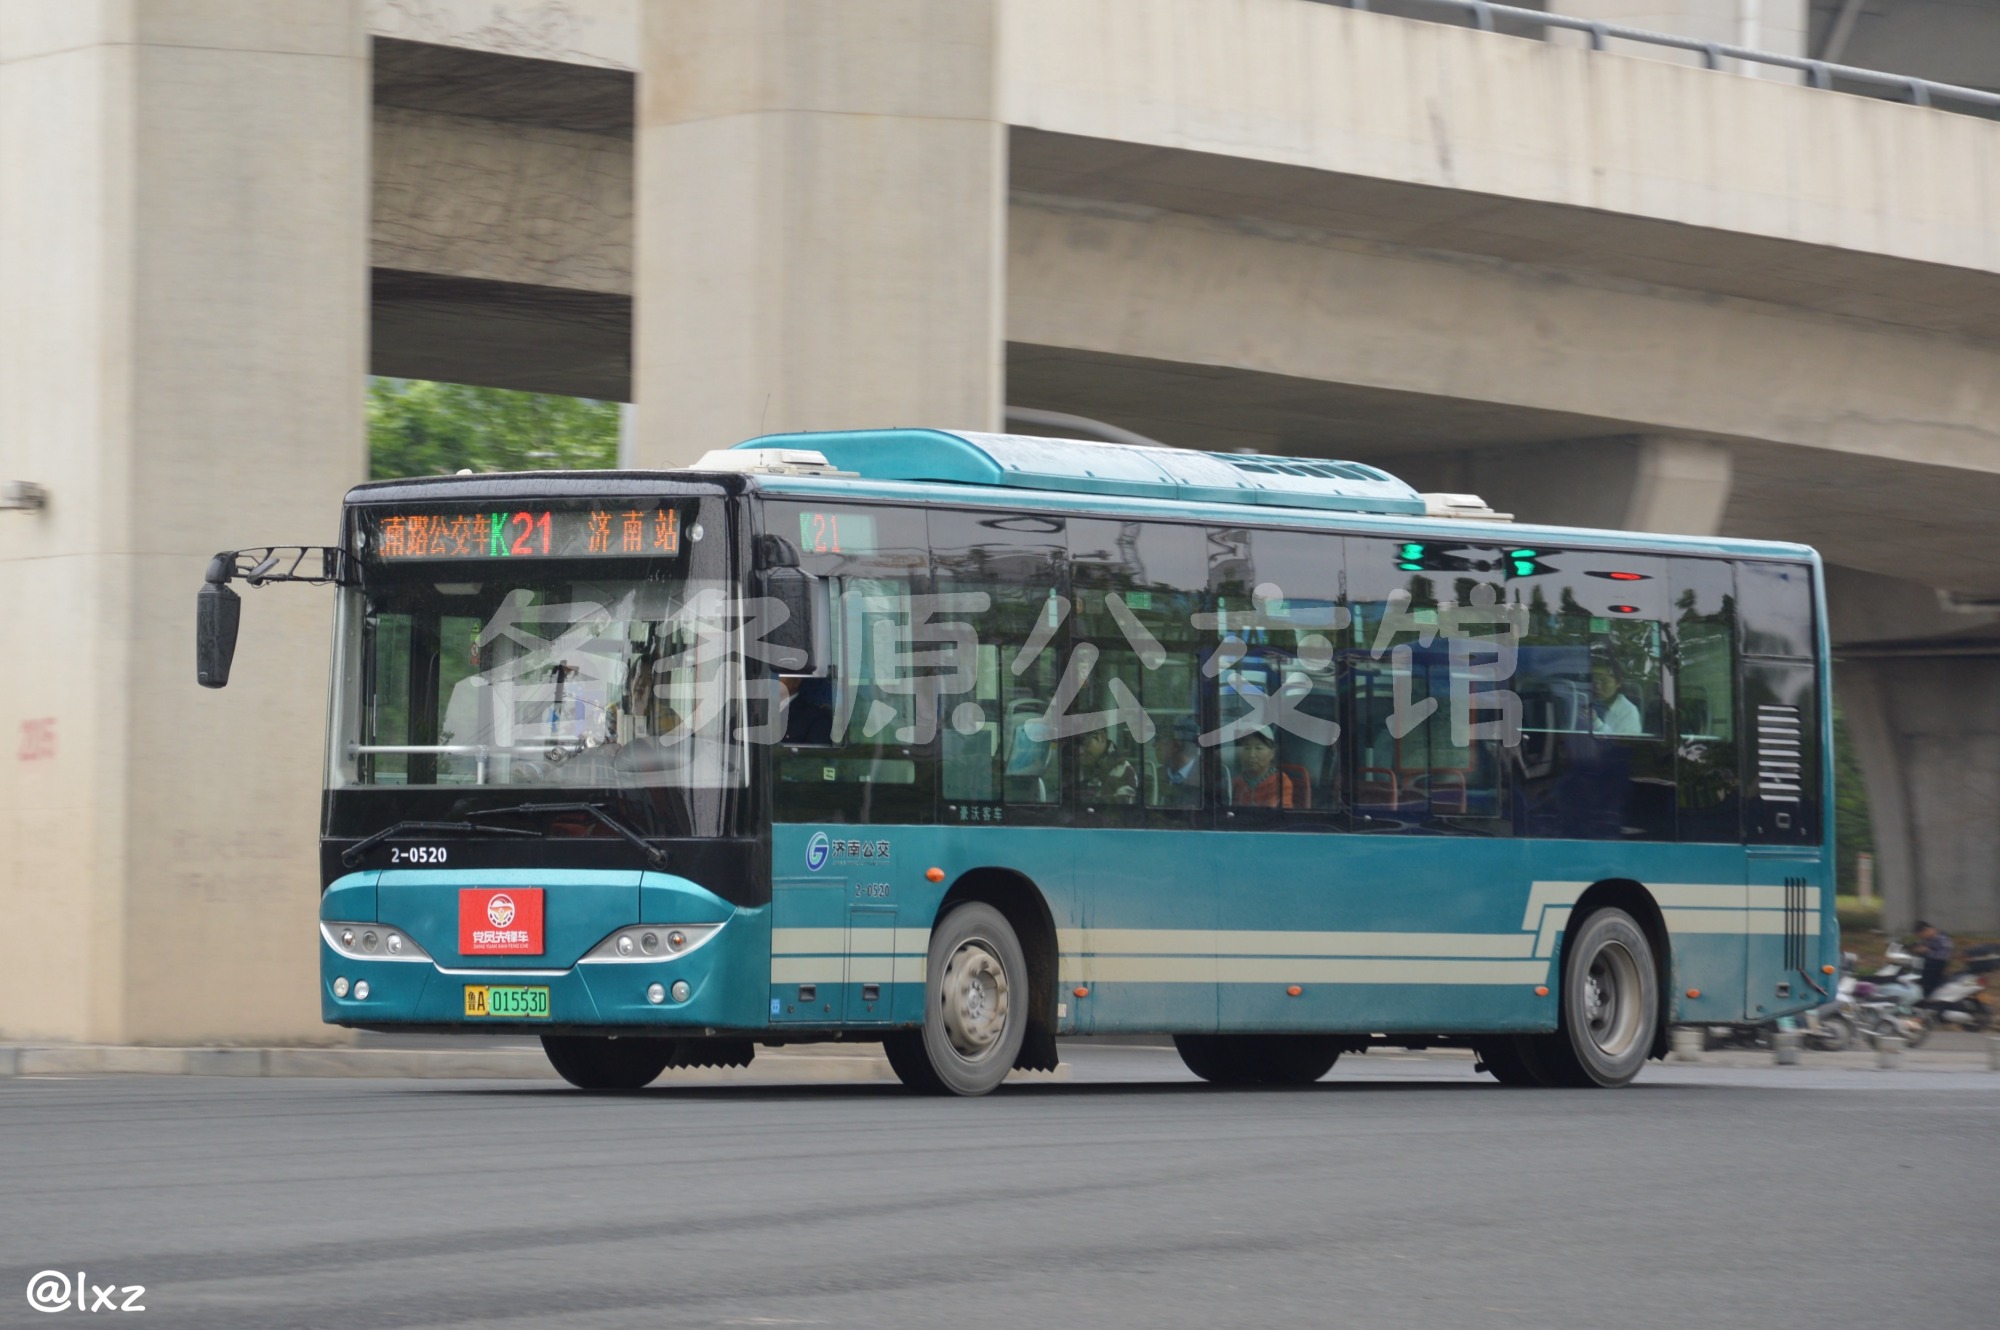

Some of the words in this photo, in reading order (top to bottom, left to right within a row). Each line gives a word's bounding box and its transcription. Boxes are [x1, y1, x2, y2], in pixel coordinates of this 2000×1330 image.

[490, 511, 551, 556] K21
[588, 508, 678, 553] 济南站
[391, 847, 447, 864] 2-0520
[831, 839, 891, 858] 济南公交
[855, 884, 890, 897] 2-0520
[472, 930, 529, 943] 党员先锋车
